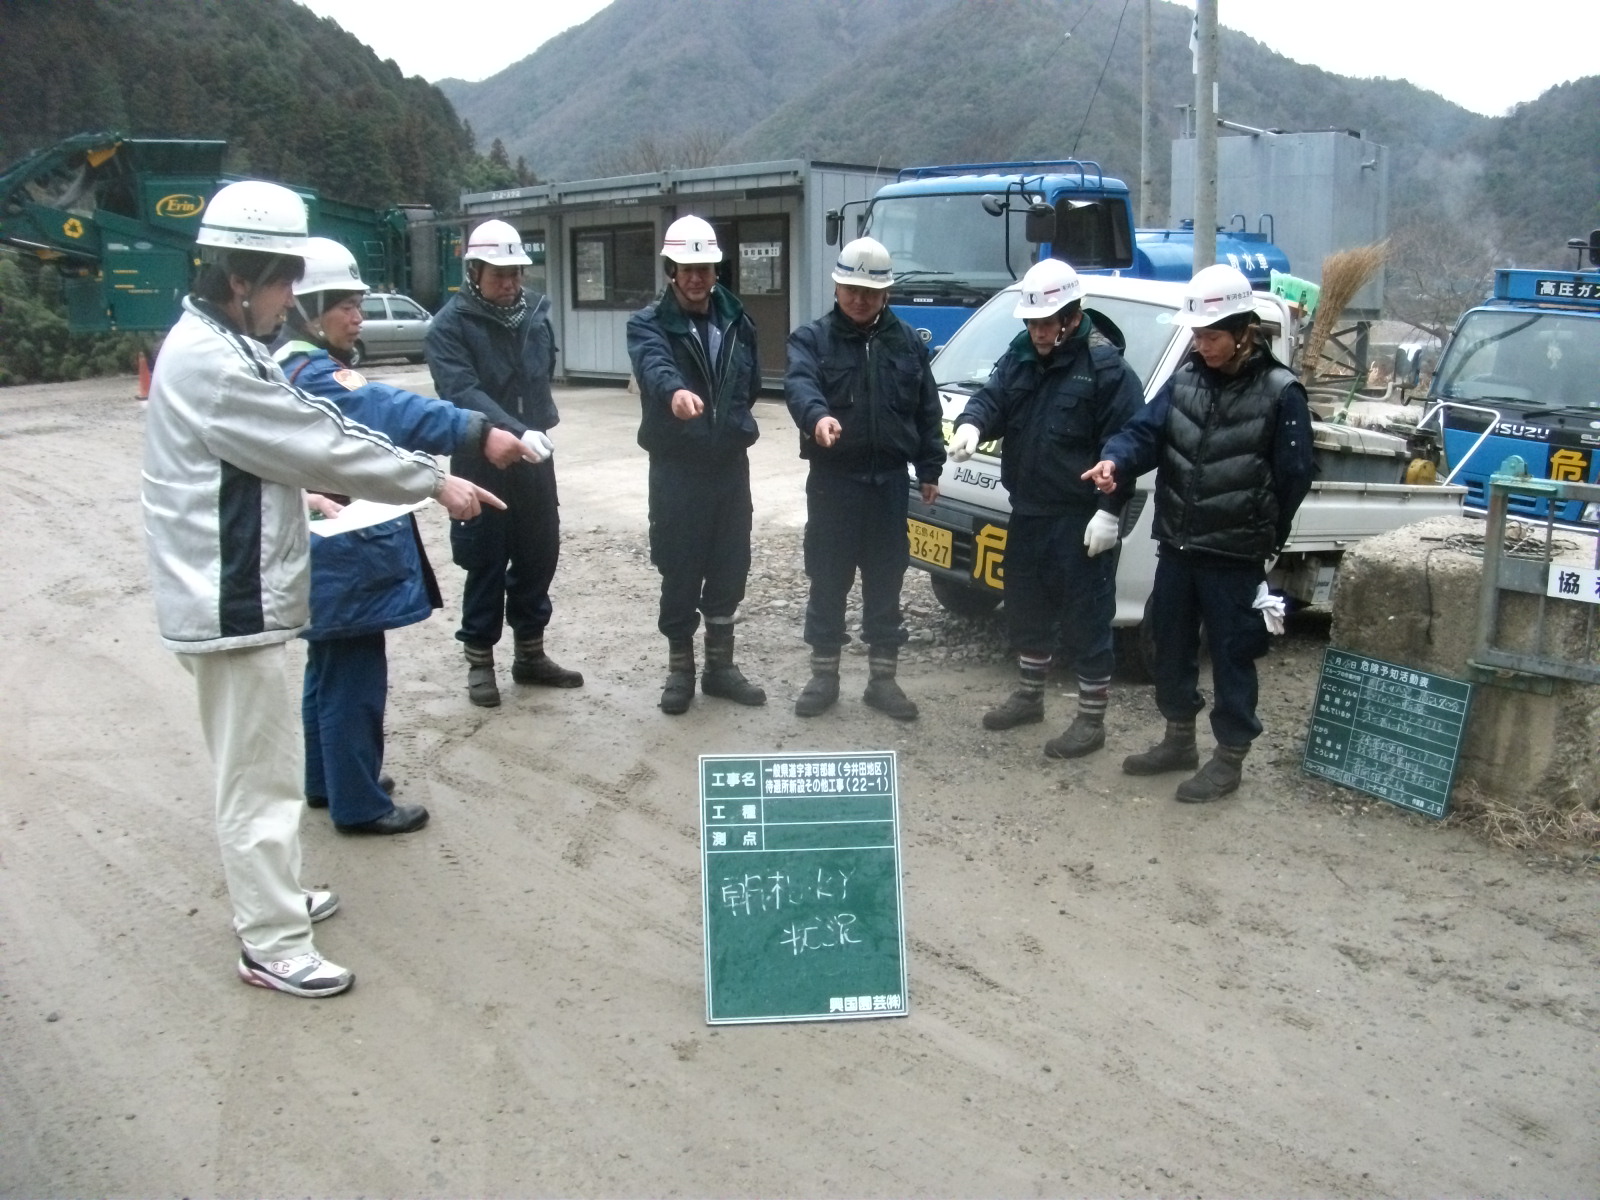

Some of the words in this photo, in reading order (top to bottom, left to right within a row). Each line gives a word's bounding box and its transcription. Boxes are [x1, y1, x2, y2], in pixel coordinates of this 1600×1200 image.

[166, 199, 195, 211] Erin
[1495, 423, 1550, 439] ISUZU
[1550, 448, 1588, 481] 危
[929, 529, 938, 540] 41
[913, 536, 949, 564] 36-27
[1360, 660, 1430, 688] 危険予知活動表
[711, 772, 757, 788] 工事名
[711, 804, 757, 820] 工種
[712, 830, 758, 847] 測点
[780, 913, 863, 956] 状況
